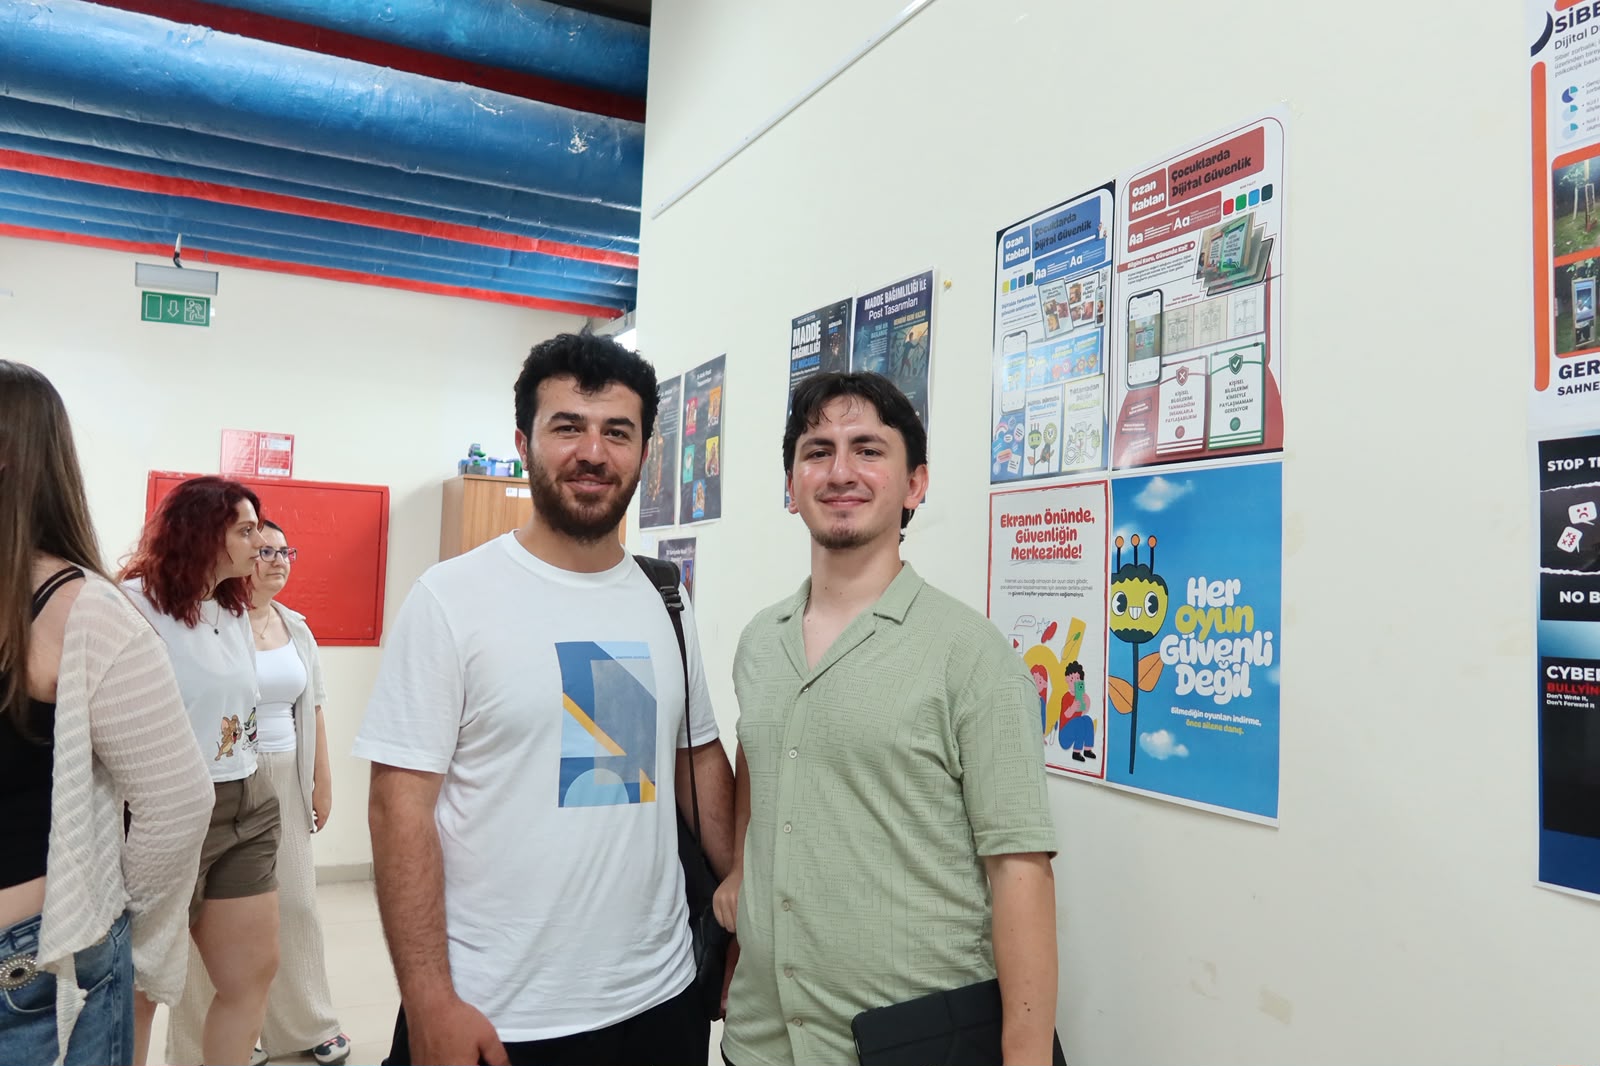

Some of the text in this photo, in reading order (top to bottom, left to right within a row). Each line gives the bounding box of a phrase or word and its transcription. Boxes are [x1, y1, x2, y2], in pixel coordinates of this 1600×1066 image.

[1555, 28, 1588, 49] Dijital
[1171, 149, 1231, 182] Çocuklarda
[1171, 156, 1252, 197] Dijital Güvenlik
[1131, 180, 1157, 197] Ozan
[1131, 192, 1165, 213] Kablan
[1173, 215, 1191, 231] Aa
[1005, 236, 1024, 249] Ozan
[1034, 220, 1092, 251] Dijital Güvenlik
[1129, 232, 1144, 247] Aa
[1005, 246, 1030, 263] Kablan
[1070, 255, 1083, 268] Aa
[1035, 267, 1047, 281] Aa
[864, 293, 884, 311] MADDE
[868, 306, 883, 321] Post
[792, 319, 821, 347] MADDE
[1557, 381, 1600, 396] SAHNE
[1547, 458, 1584, 472] STOP
[1000, 507, 1095, 528] Ekranın Önünde,
[1015, 527, 1077, 545] Güvenliğin
[1011, 543, 1082, 561] Merkezinde!
[1186, 576, 1241, 608] Her
[1559, 591, 1585, 603] NO
[1175, 605, 1254, 642] oyun
[1159, 630, 1273, 667] Güvenli
[1175, 660, 1252, 705] Değil
[1170, 706, 1204, 719] Bilmediğin
